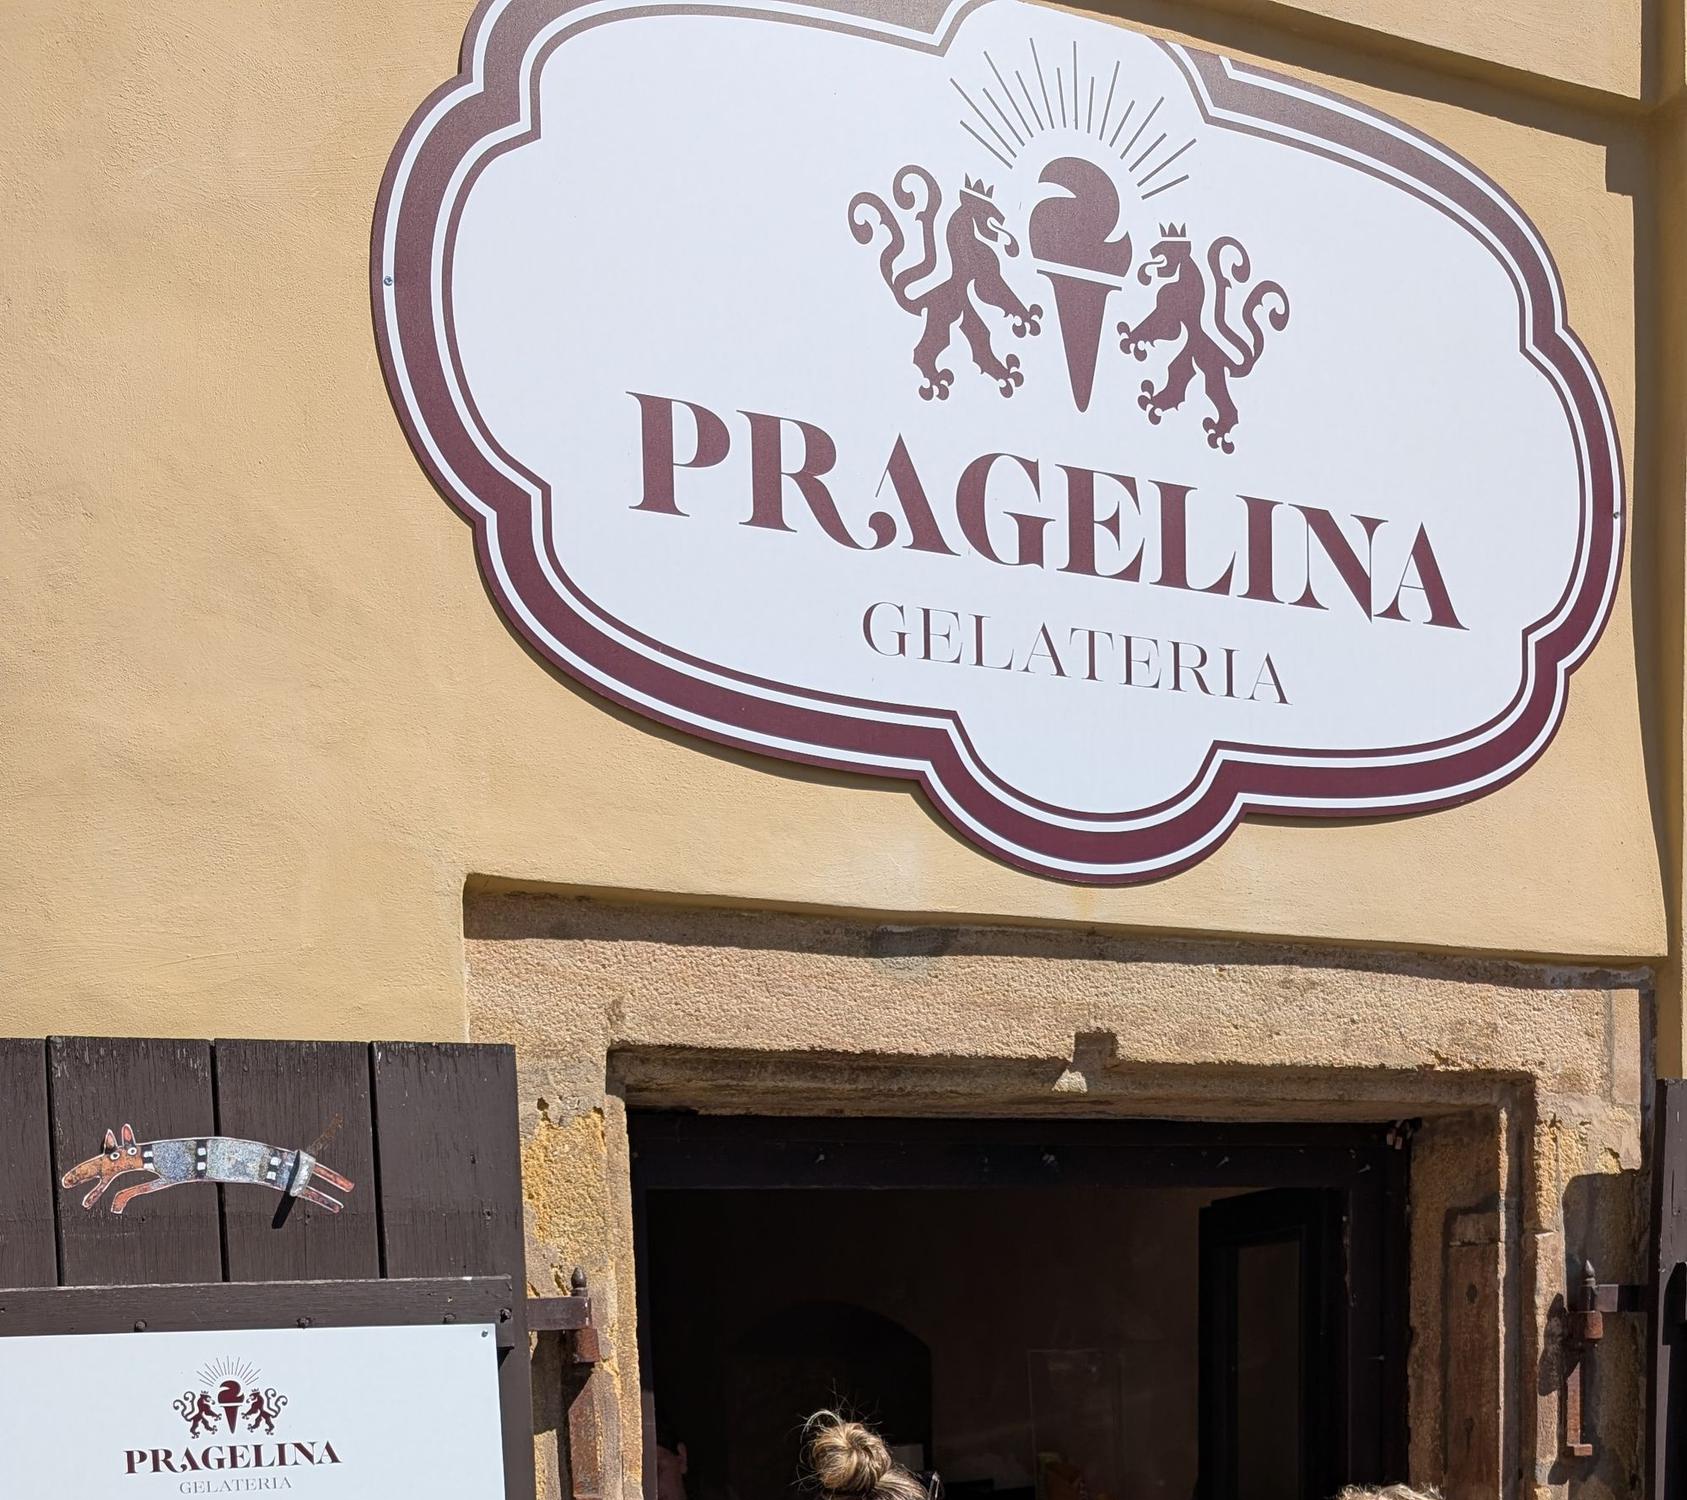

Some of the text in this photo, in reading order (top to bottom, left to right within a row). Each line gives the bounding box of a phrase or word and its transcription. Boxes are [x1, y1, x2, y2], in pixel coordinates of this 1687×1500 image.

[626, 390, 1471, 632] PRAGELINA
[861, 600, 1294, 706] GELATERIA
[123, 1440, 342, 1474] PRAGELINA
[179, 1477, 292, 1494] GELATERIA
